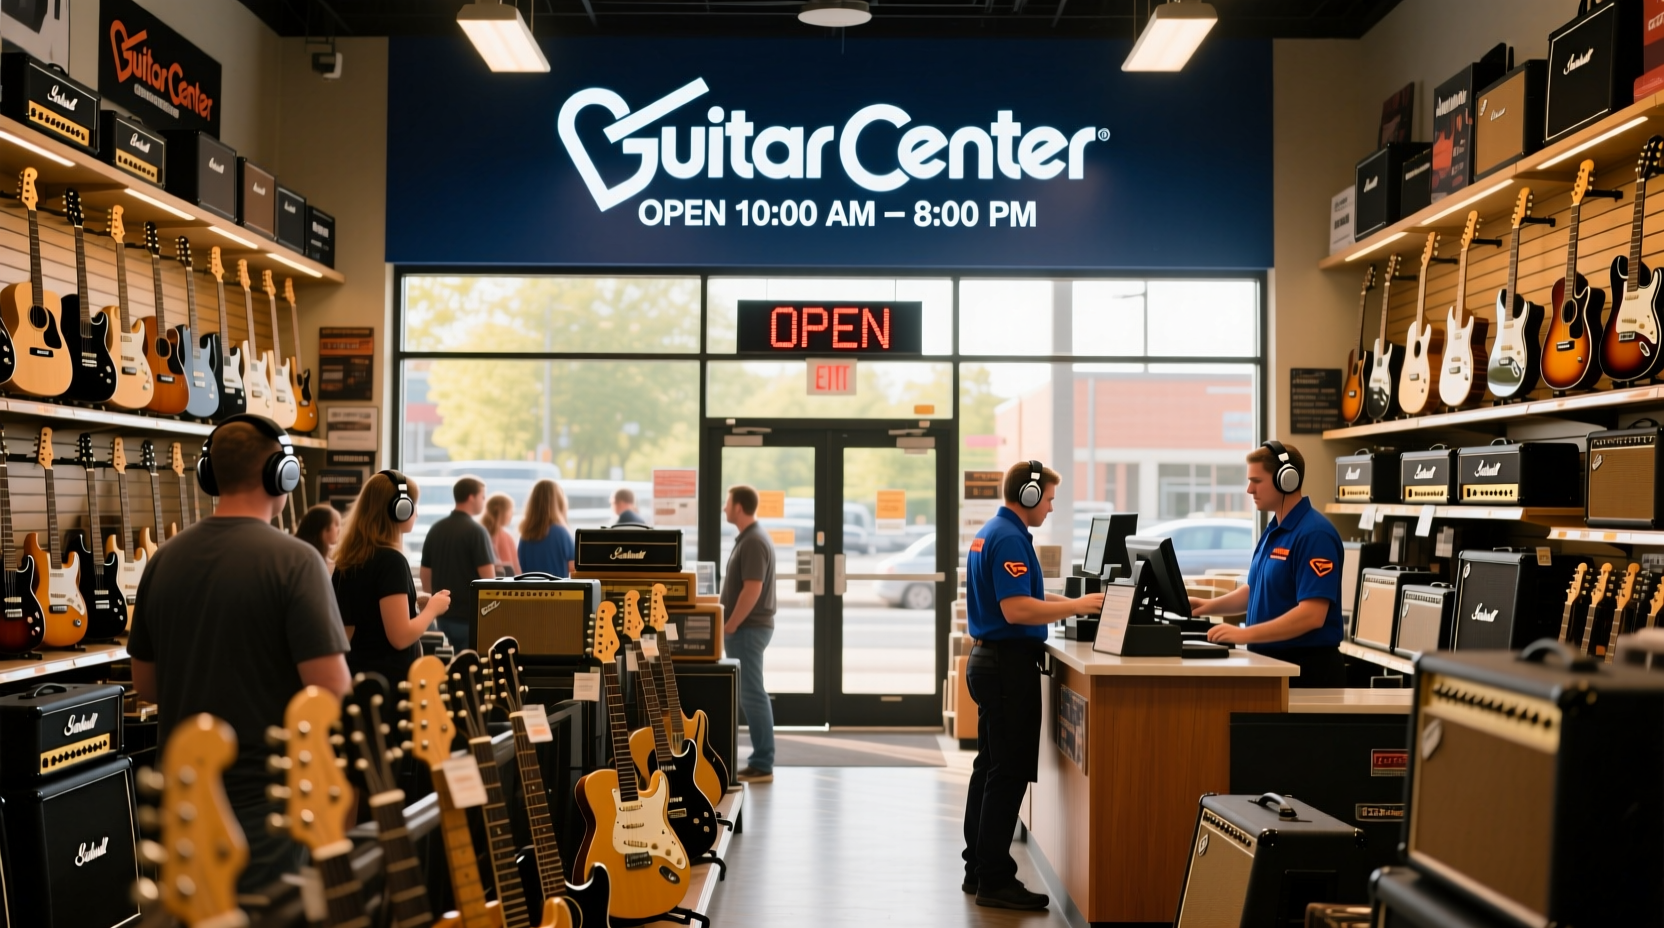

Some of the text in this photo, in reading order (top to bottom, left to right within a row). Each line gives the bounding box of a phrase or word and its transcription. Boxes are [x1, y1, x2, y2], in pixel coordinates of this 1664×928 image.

[109, 19, 168, 93] Guitar
[168, 62, 213, 121] Center
[557, 77, 835, 212] Guitar
[638, 198, 726, 228] OPEN
[735, 199, 818, 228] 10:00
[825, 200, 876, 228] AM
[913, 200, 979, 228] 8:00
[989, 200, 1037, 228] PM
[770, 306, 890, 349] OPEN
